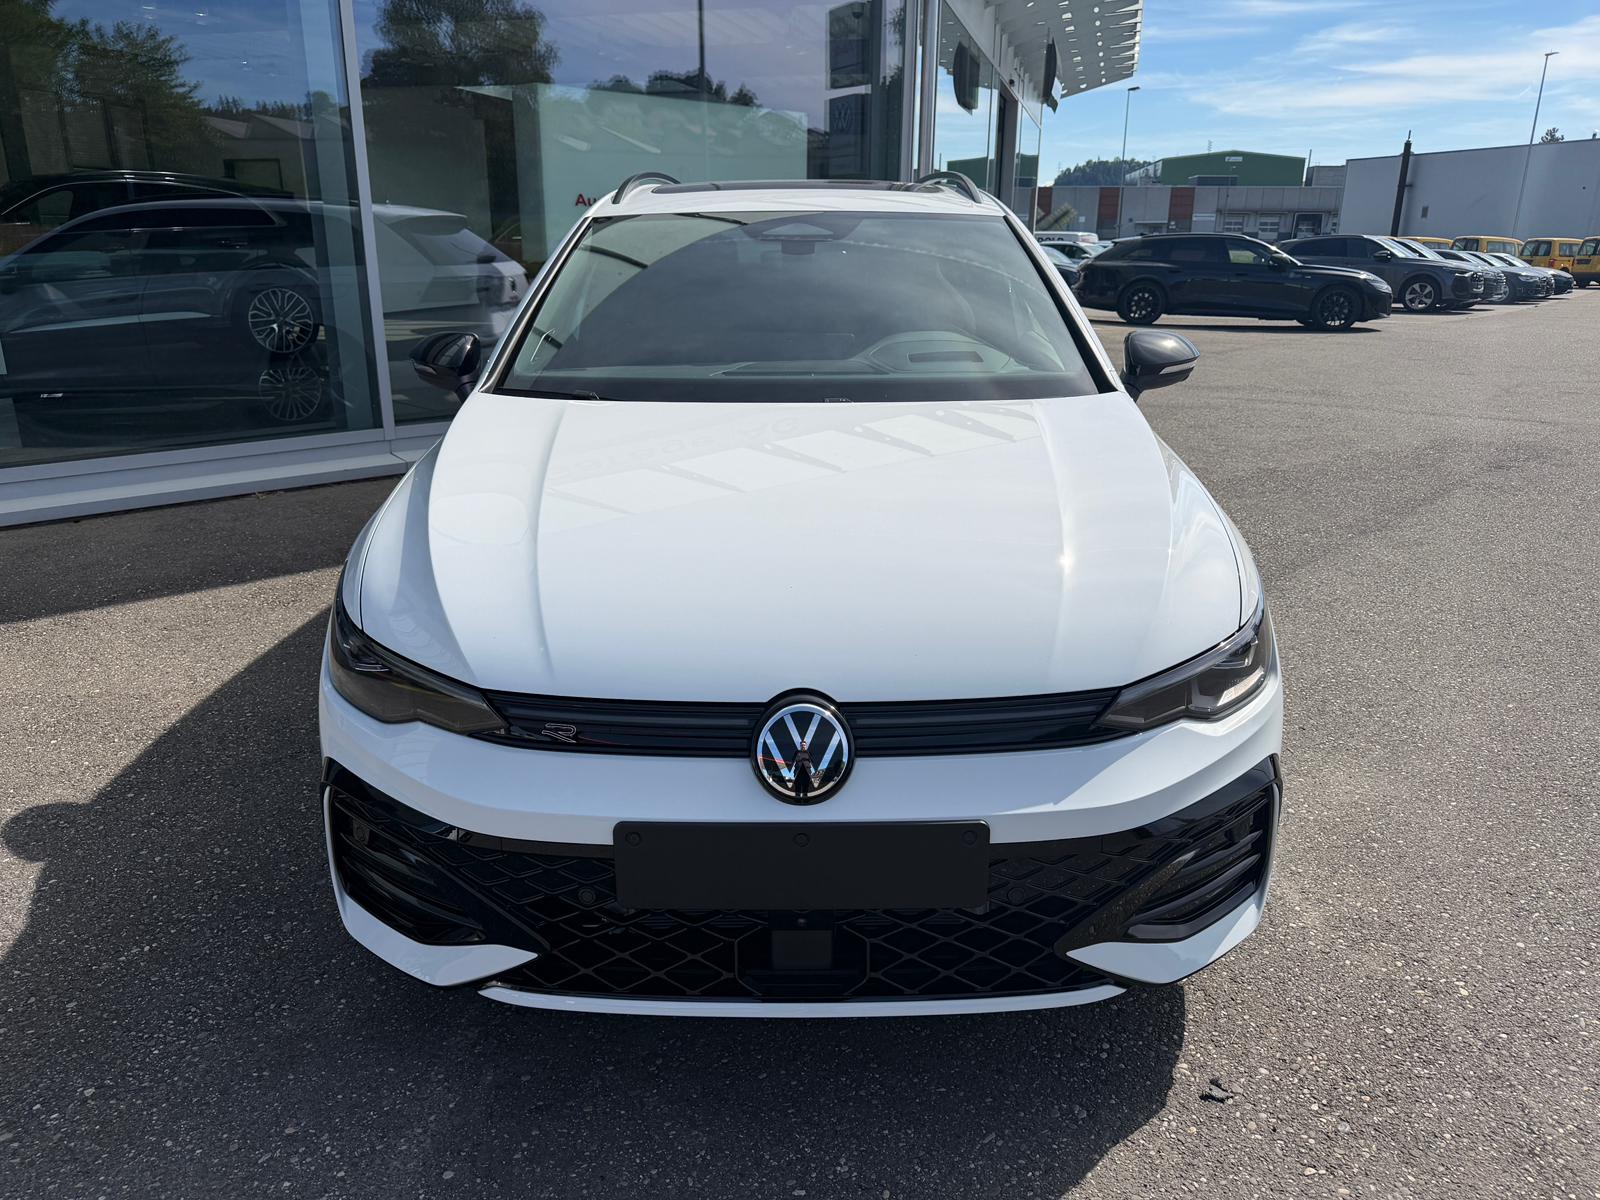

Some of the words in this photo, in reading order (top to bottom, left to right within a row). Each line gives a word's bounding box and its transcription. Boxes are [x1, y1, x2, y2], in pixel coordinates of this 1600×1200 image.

[575, 193, 598, 207] Au
[541, 723, 577, 743] R
[762, 710, 843, 791] VW
